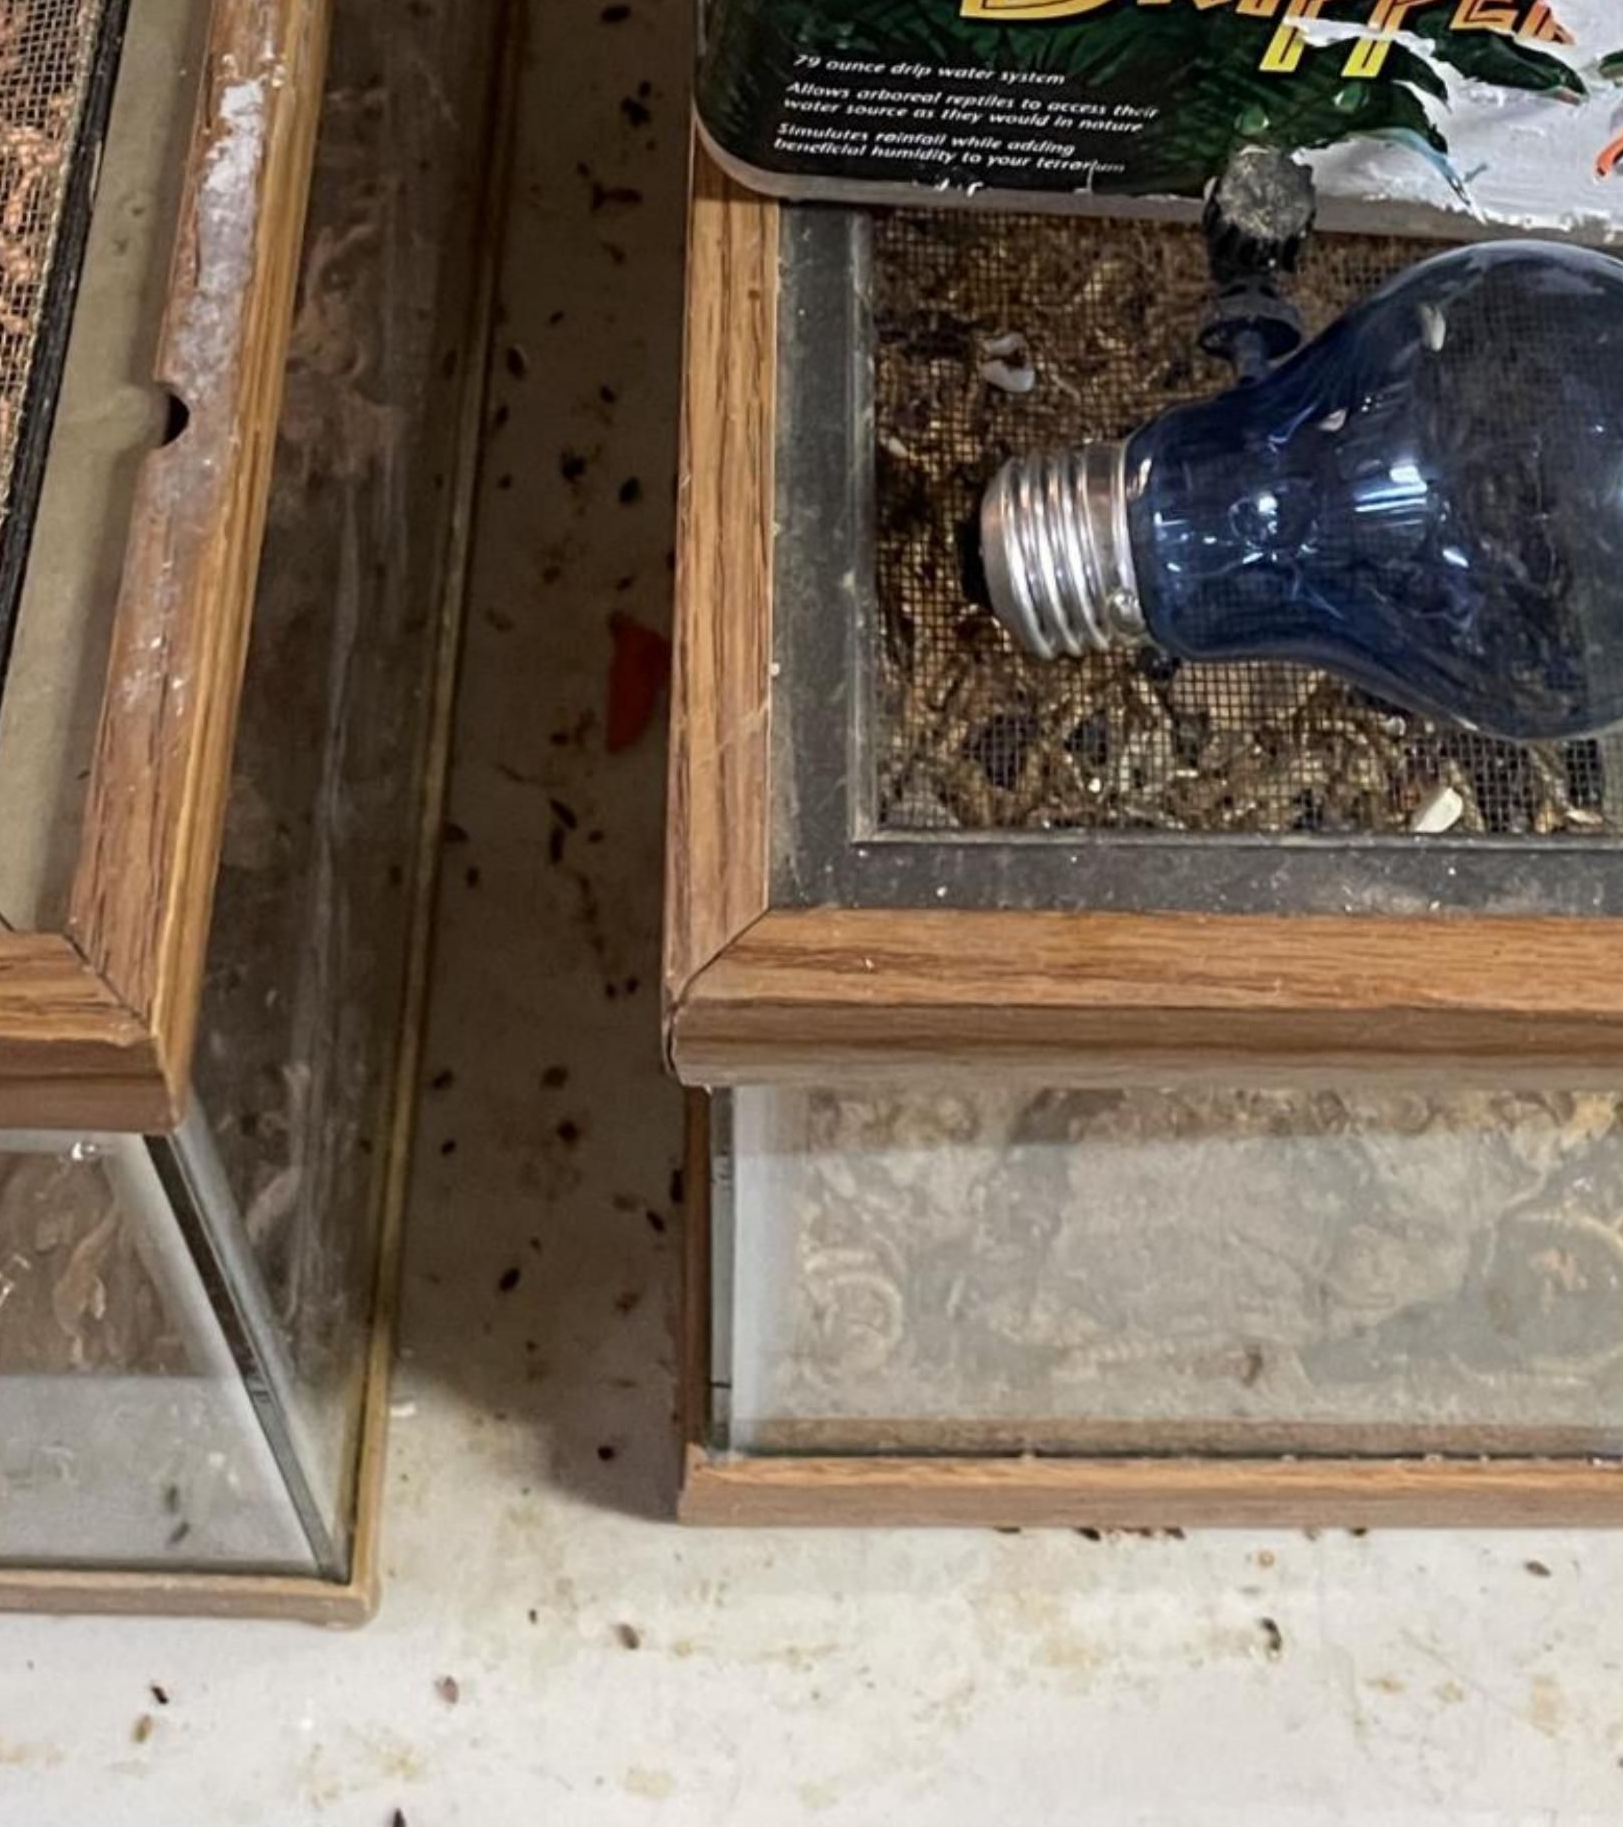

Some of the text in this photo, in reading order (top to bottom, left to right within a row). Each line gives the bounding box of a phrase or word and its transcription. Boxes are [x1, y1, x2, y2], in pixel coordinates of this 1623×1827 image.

[793, 54, 1066, 86] 79 ounce drip water system
[783, 98, 1144, 134] water source as they would in nature
[786, 81, 1160, 119] Allows arboreal reptiles to access their
[773, 137, 1126, 174] beneficial humidity to your terrarium
[777, 122, 1077, 158] Simulates rainfall while adding
